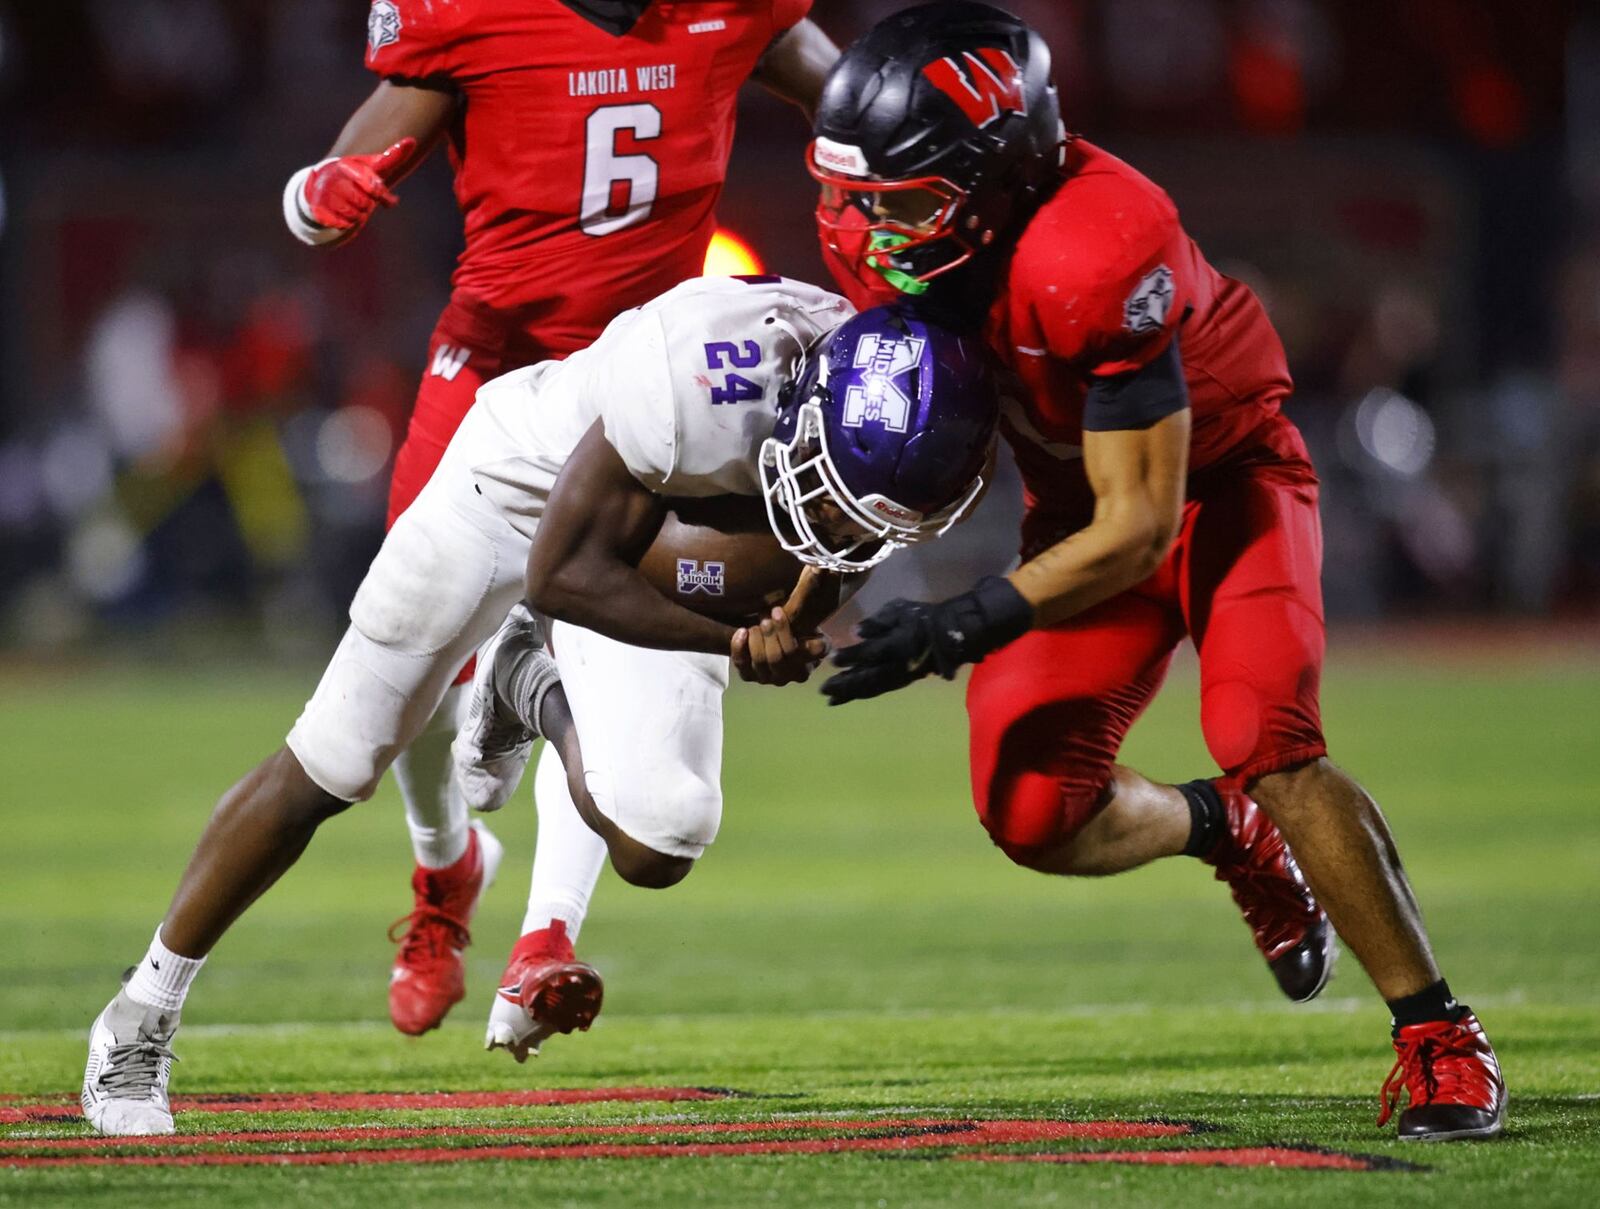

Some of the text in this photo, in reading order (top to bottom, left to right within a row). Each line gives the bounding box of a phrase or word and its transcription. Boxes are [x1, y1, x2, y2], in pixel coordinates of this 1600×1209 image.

[568, 63, 677, 97] LAKOTA WEST
[921, 47, 1028, 130] W
[579, 102, 662, 237] 6
[431, 343, 472, 381] W
[704, 339, 764, 405] 24
[842, 333, 926, 434] M
[864, 339, 896, 421] MIDES
